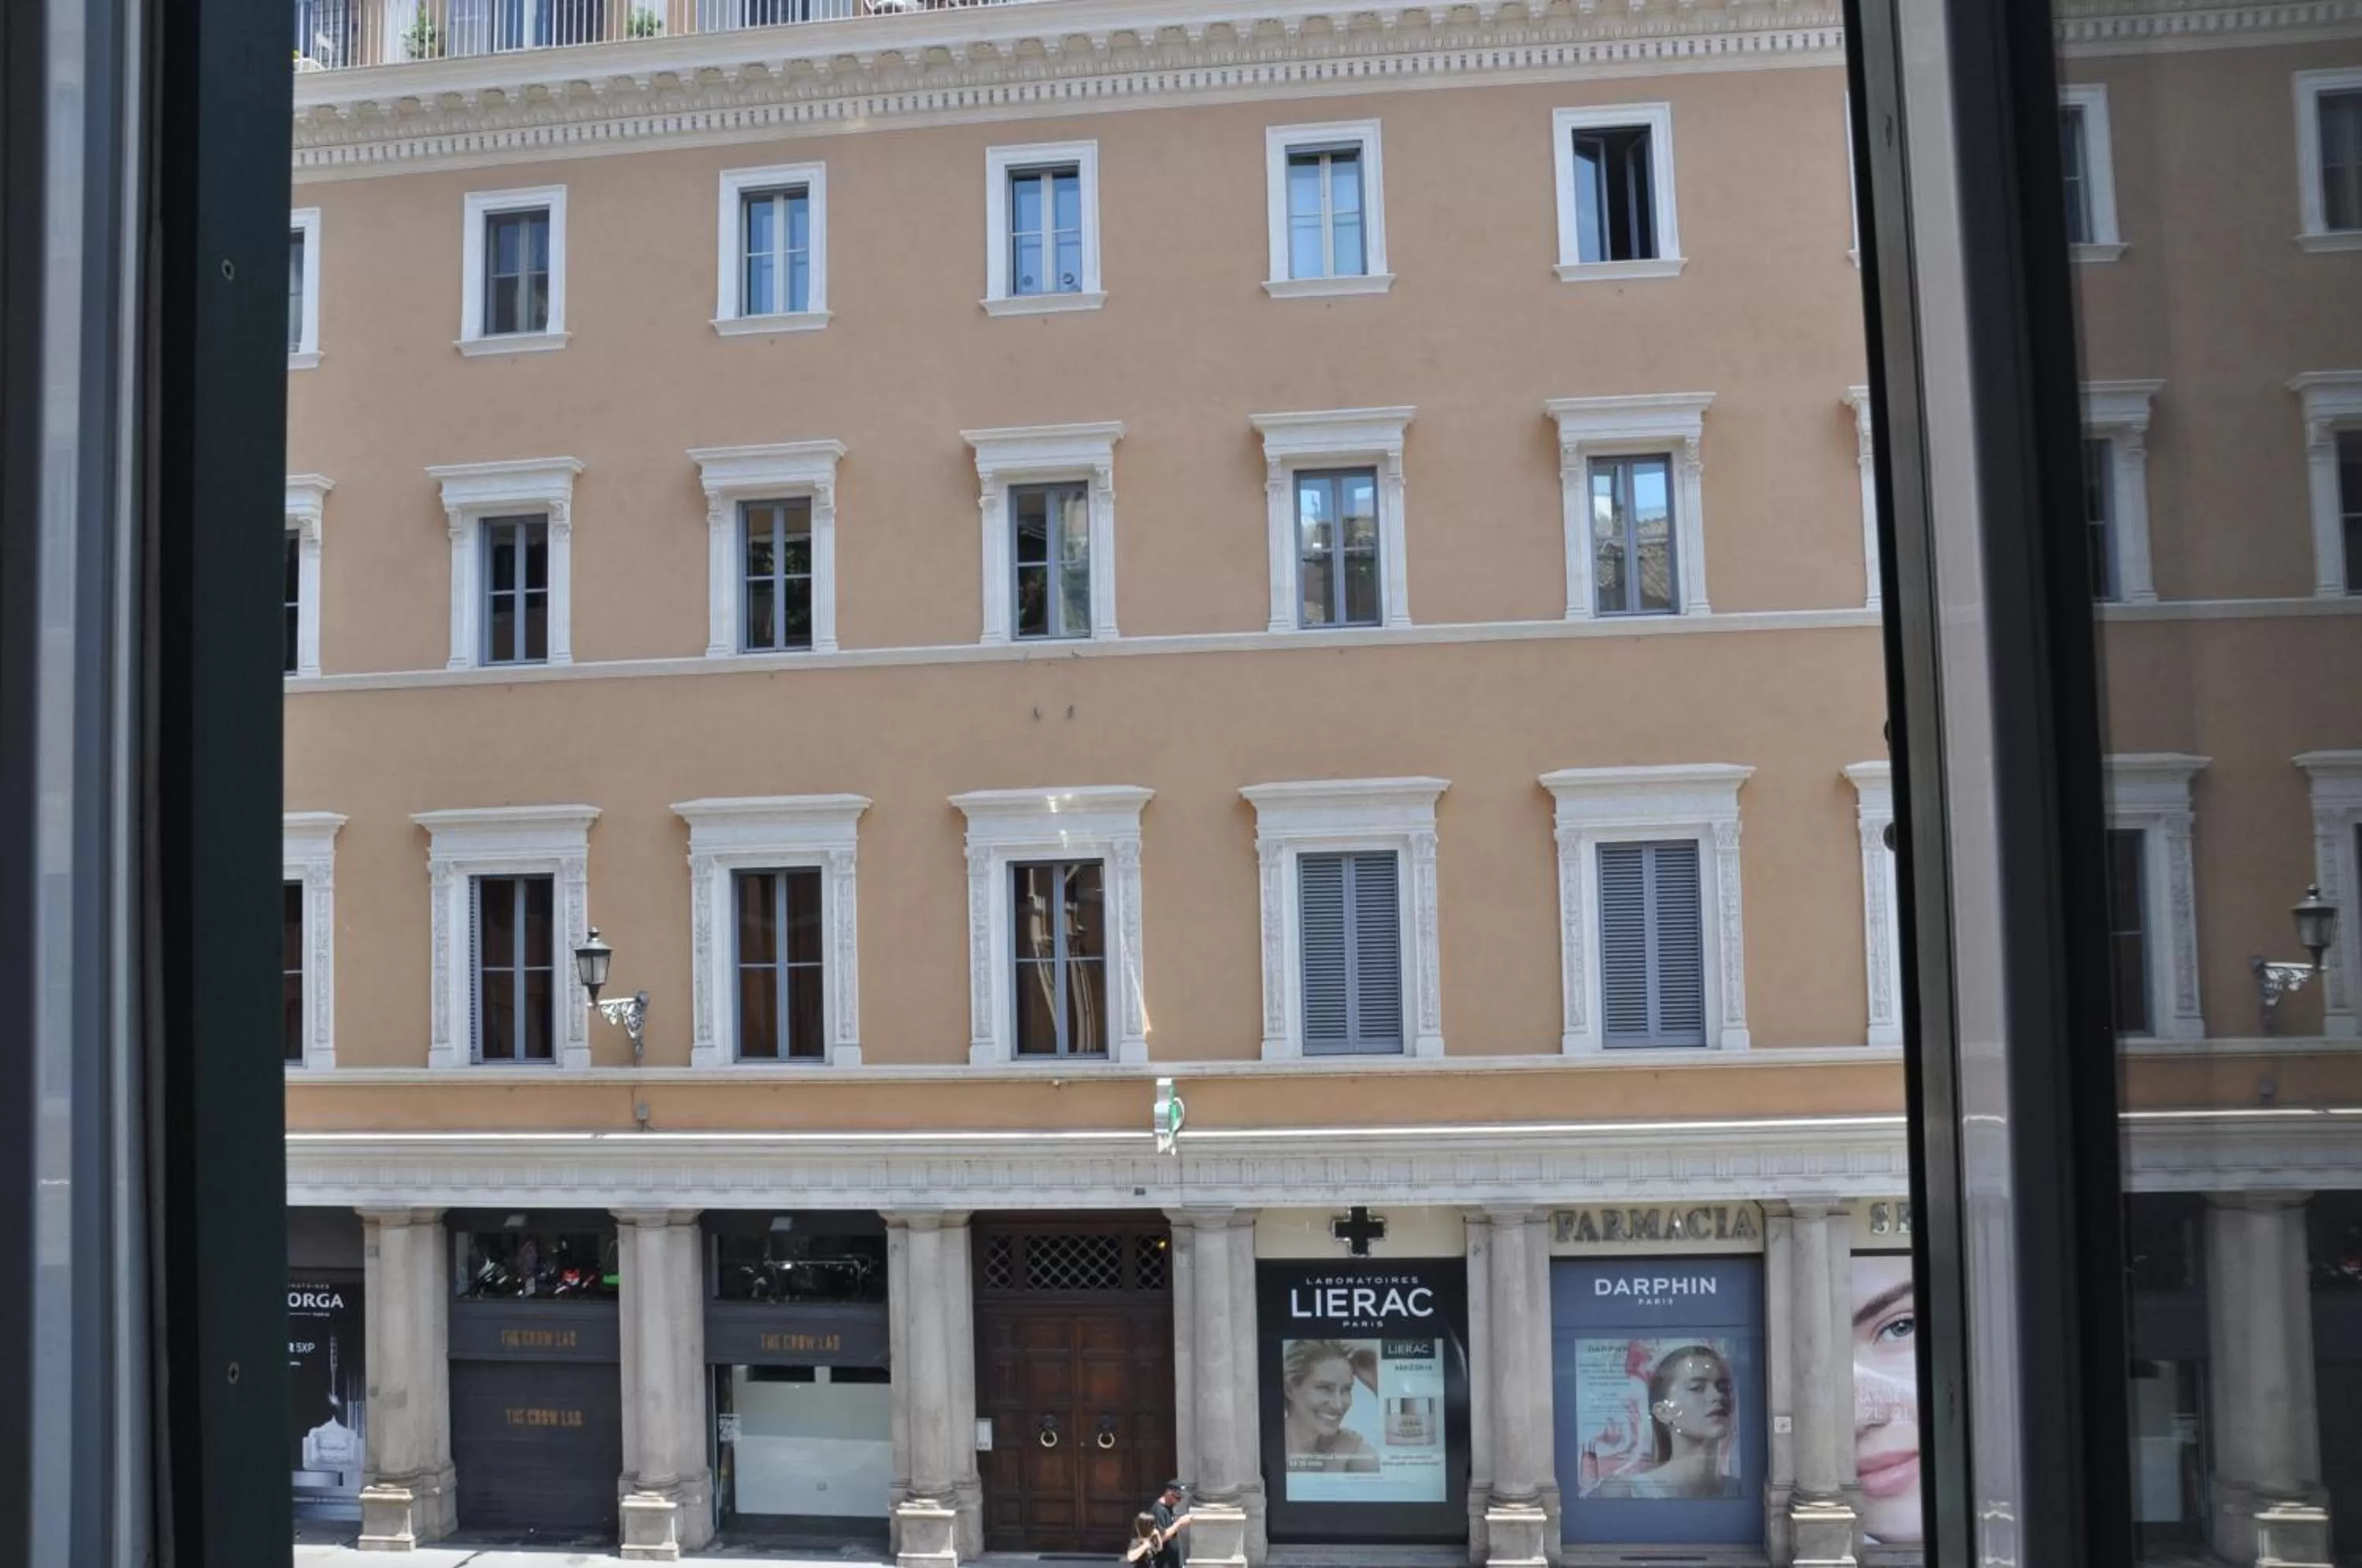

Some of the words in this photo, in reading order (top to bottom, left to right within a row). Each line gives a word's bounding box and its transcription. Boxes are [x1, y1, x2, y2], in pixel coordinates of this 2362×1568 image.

[1554, 1206, 1757, 1241] FARMACIA
[1306, 1276, 1420, 1285] LABORATOIRES
[1594, 1277, 1717, 1296] DARPHIN
[1291, 1287, 1435, 1318] LIERAC
